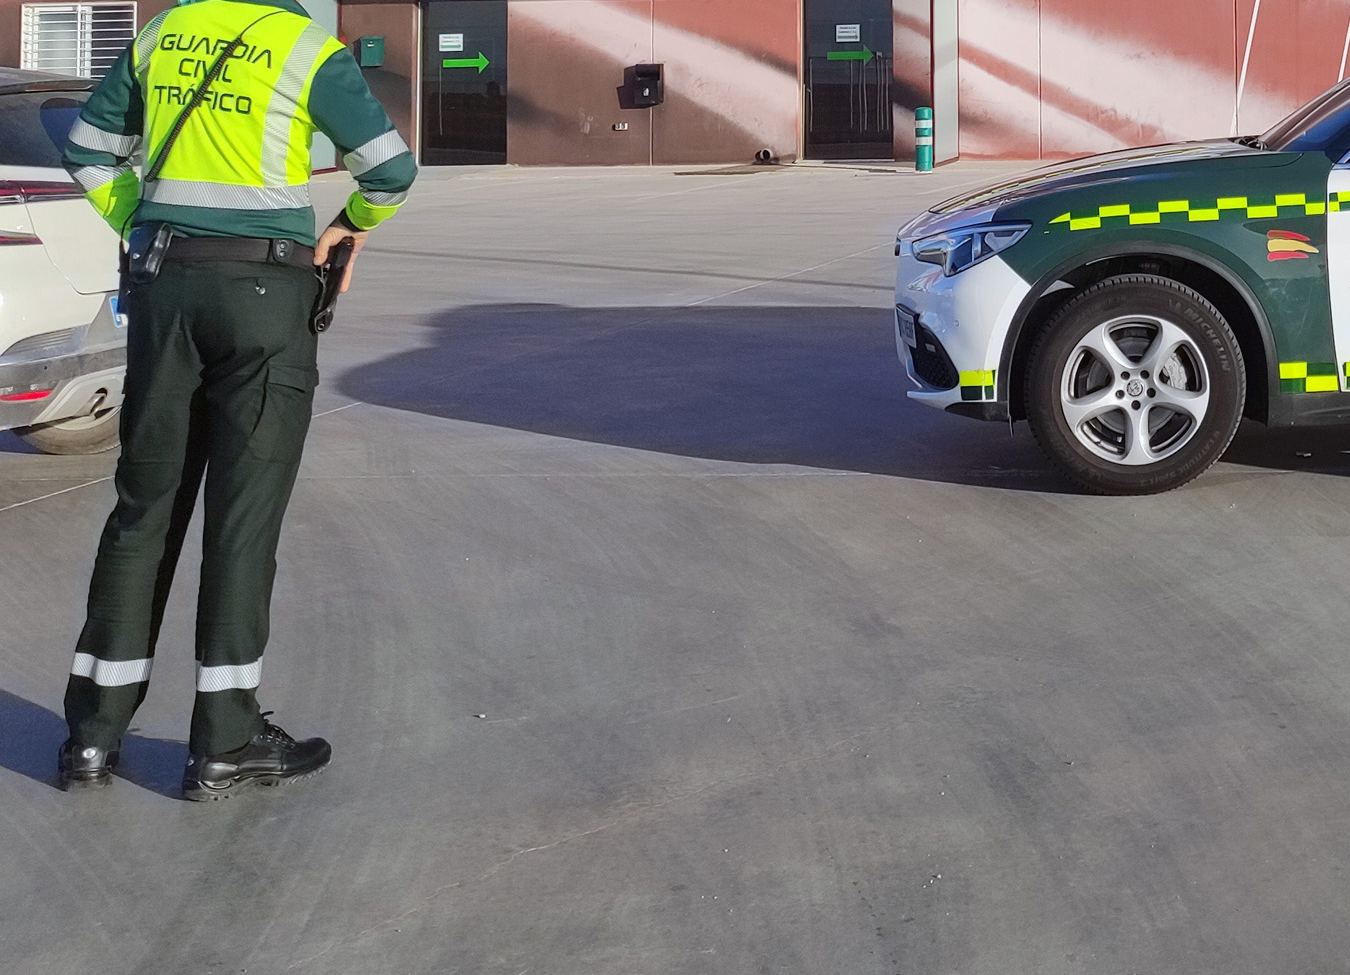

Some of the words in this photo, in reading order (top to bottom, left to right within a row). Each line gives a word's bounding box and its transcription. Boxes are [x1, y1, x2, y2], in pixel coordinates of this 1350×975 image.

[160, 34, 271, 69] GUARDIA
[154, 84, 252, 115] TRÁFICO
[1184, 308, 1231, 372] MICHELIN
